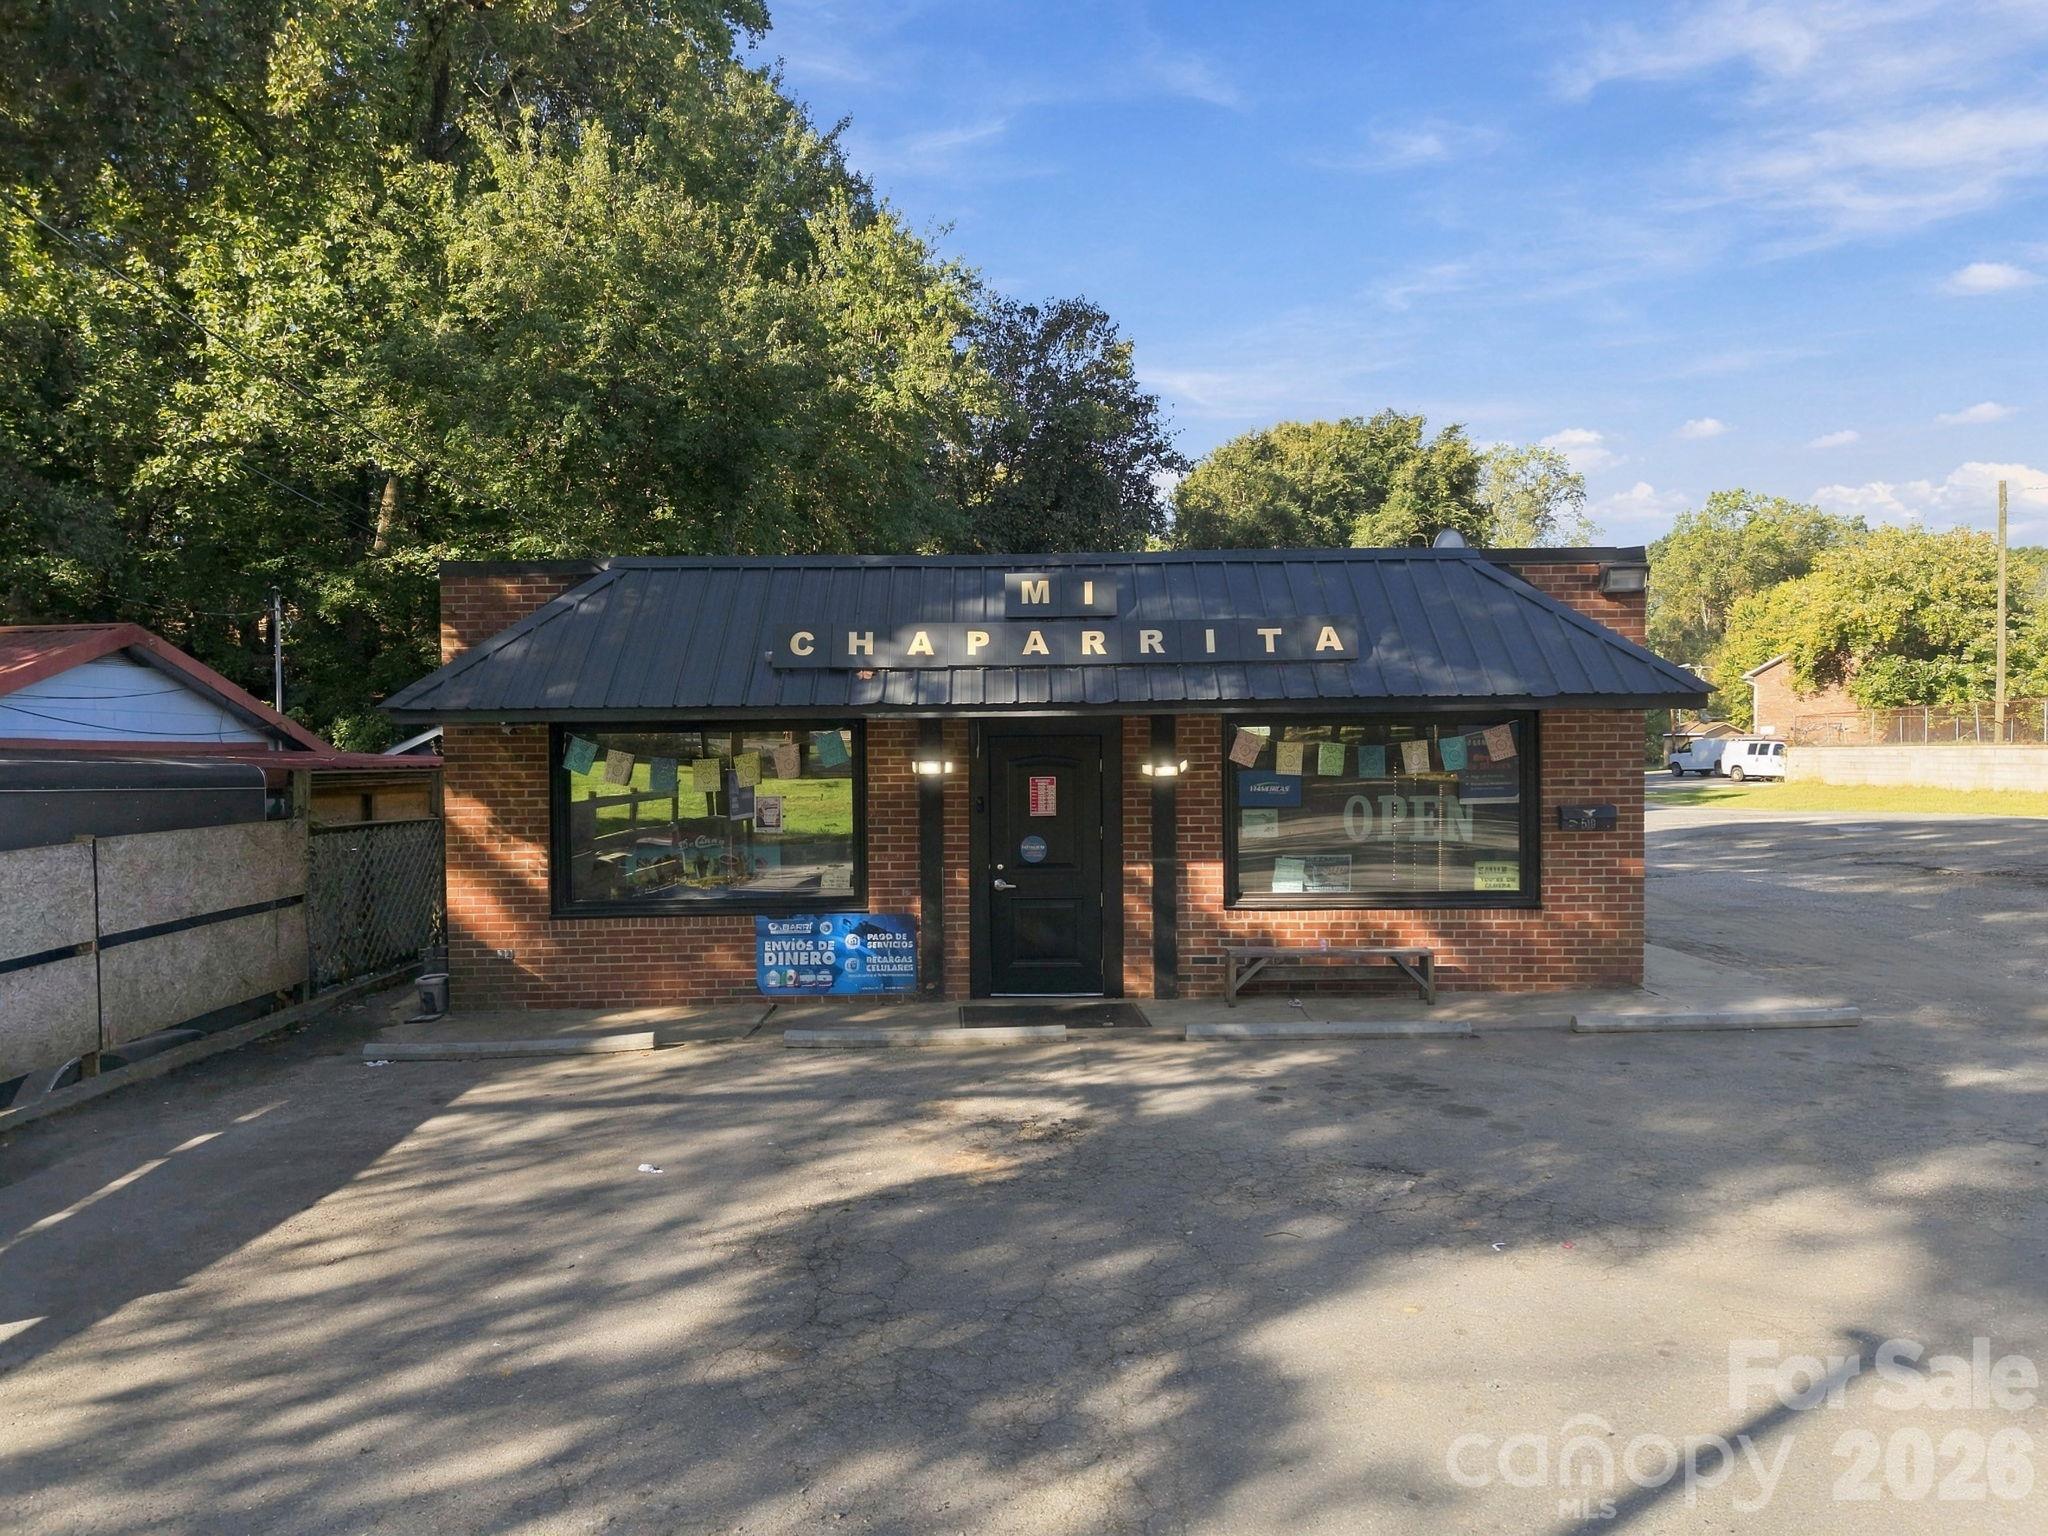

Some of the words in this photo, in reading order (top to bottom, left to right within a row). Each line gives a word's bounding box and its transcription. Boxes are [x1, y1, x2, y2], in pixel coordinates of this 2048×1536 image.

[1020, 579, 1094, 605] MI
[789, 625, 1344, 656] CHAPARRITA
[1343, 794, 1474, 842] OPEN
[867, 933, 893, 941] PAGO
[895, 933, 907, 941] DE
[818, 940, 835, 951] DE
[866, 941, 914, 949] SERVICIOS
[764, 951, 836, 966] DINERO
[866, 964, 914, 972] CELULARES
